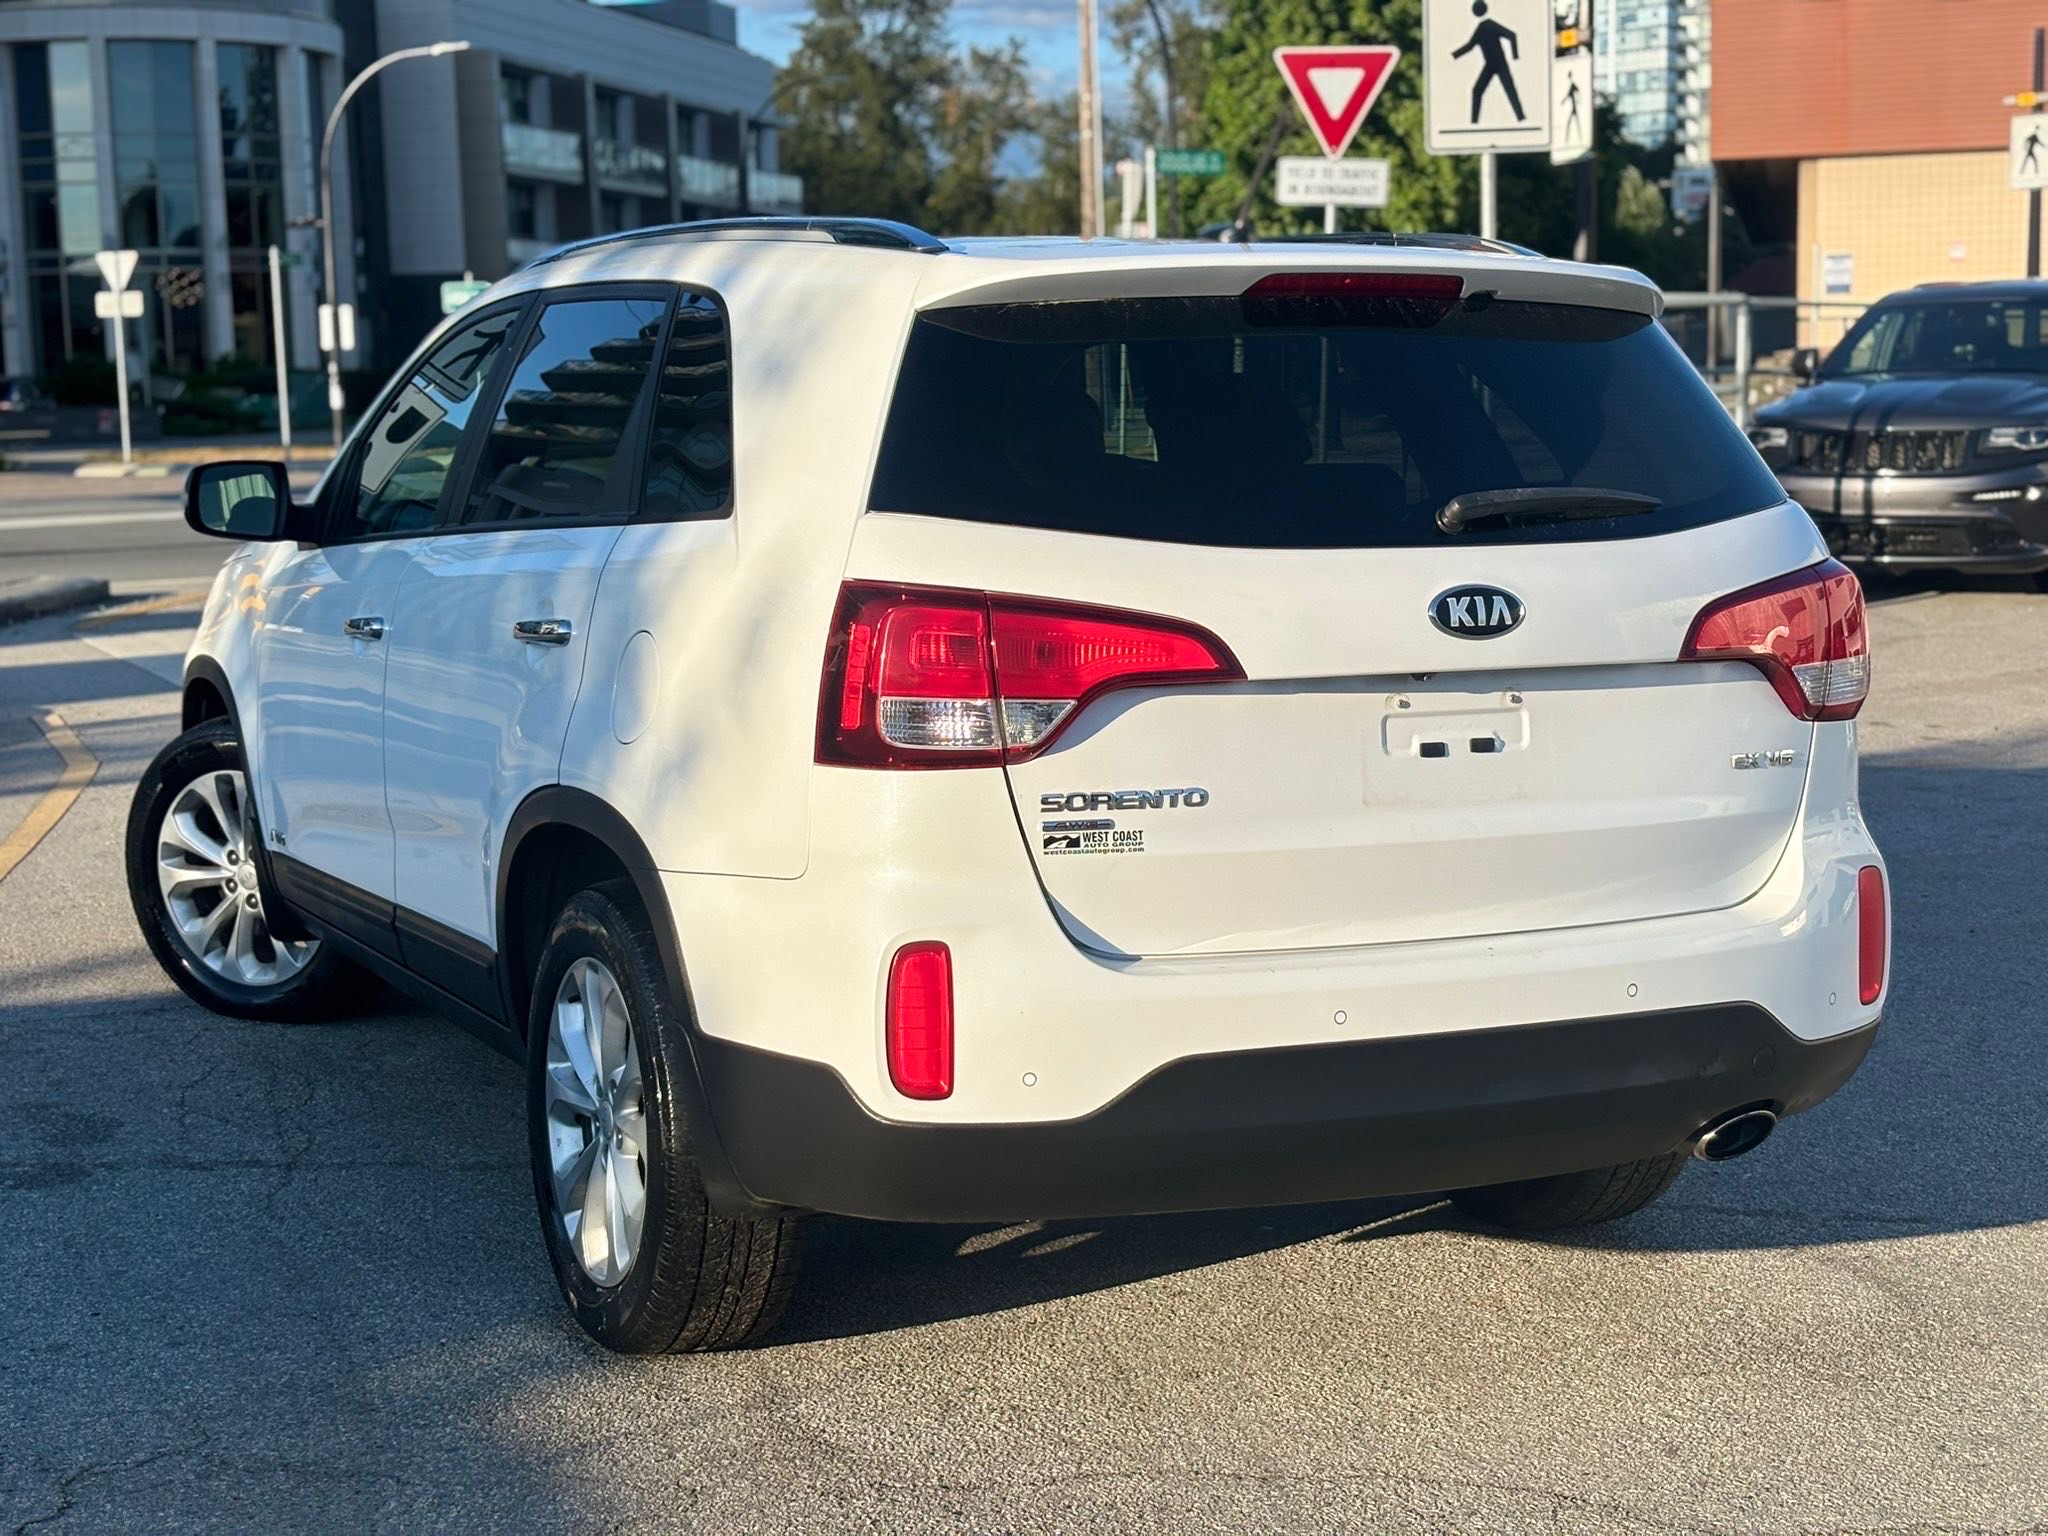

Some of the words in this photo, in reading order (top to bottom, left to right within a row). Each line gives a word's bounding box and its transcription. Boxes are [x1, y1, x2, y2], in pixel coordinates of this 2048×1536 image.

[1446, 595, 1513, 627] KIA
[1730, 752, 1760, 769] EX
[1764, 748, 1795, 767] V6
[1040, 787, 1210, 813] SORENTO
[1082, 831, 1109, 843] WEST
[1112, 830, 1144, 842] COAST
[1043, 847, 1145, 856] westcoastautogroup.com
